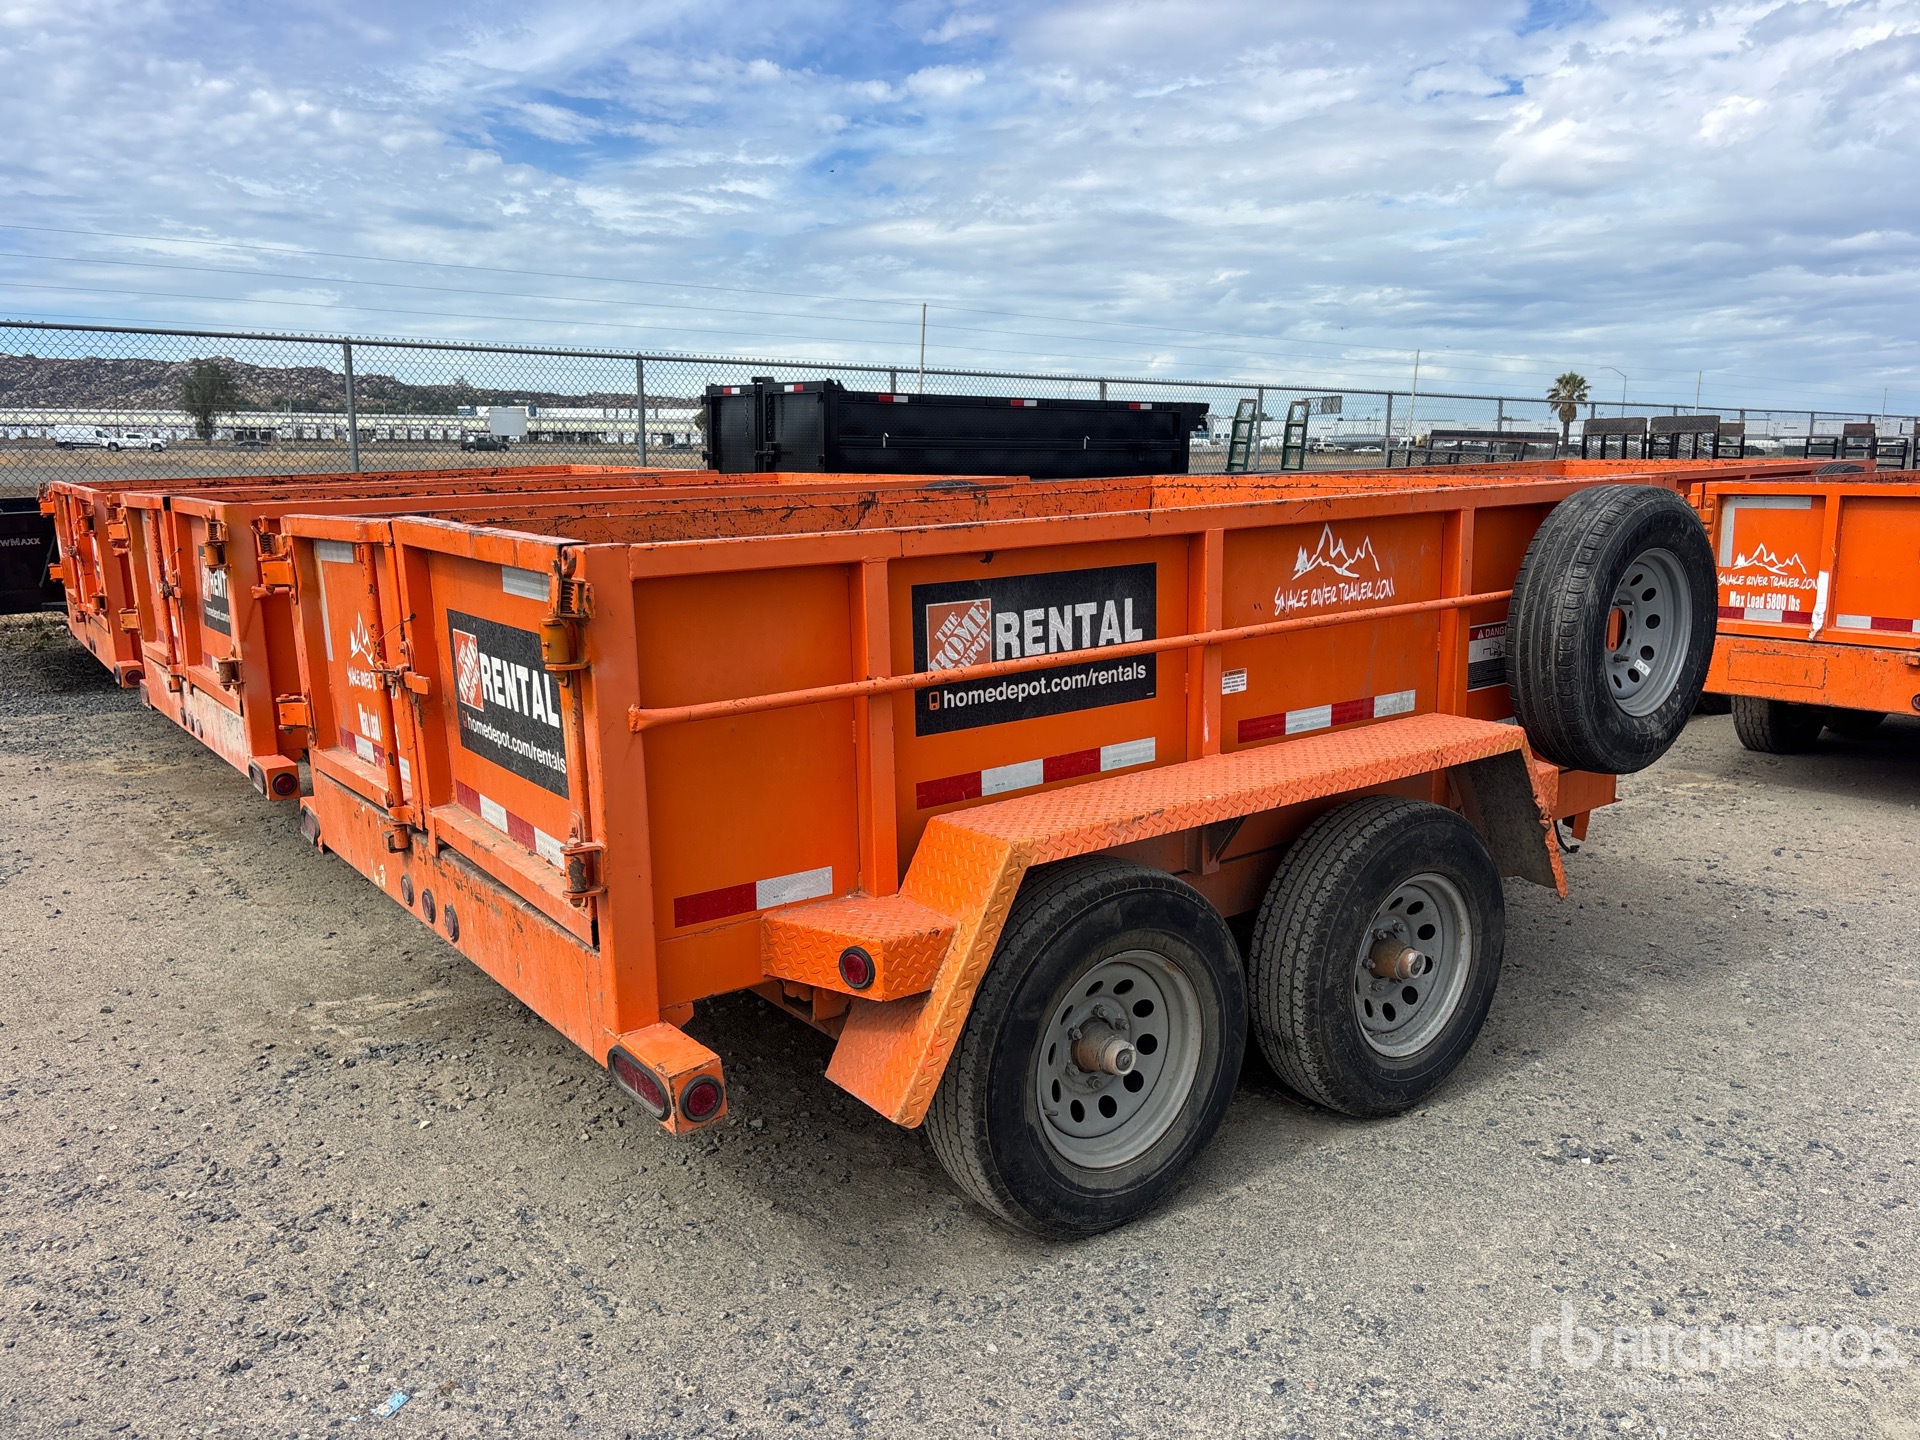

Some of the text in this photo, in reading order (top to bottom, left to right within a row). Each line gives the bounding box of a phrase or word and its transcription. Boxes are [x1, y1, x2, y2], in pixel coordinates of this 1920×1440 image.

[1274, 586, 1309, 616] SNAKE
[1310, 582, 1338, 608] RIVER
[1718, 571, 1745, 586] SNAKE
[1746, 574, 1768, 587] RIVER
[1729, 591, 1800, 611] Max Load 5800 lbs
[934, 611, 961, 643] THE
[996, 598, 1143, 660] RENTAL
[479, 652, 561, 728] RENTAL
[943, 662, 1147, 709] homedepot.com/rentals
[466, 711, 567, 774] homedepot.com/rentals
